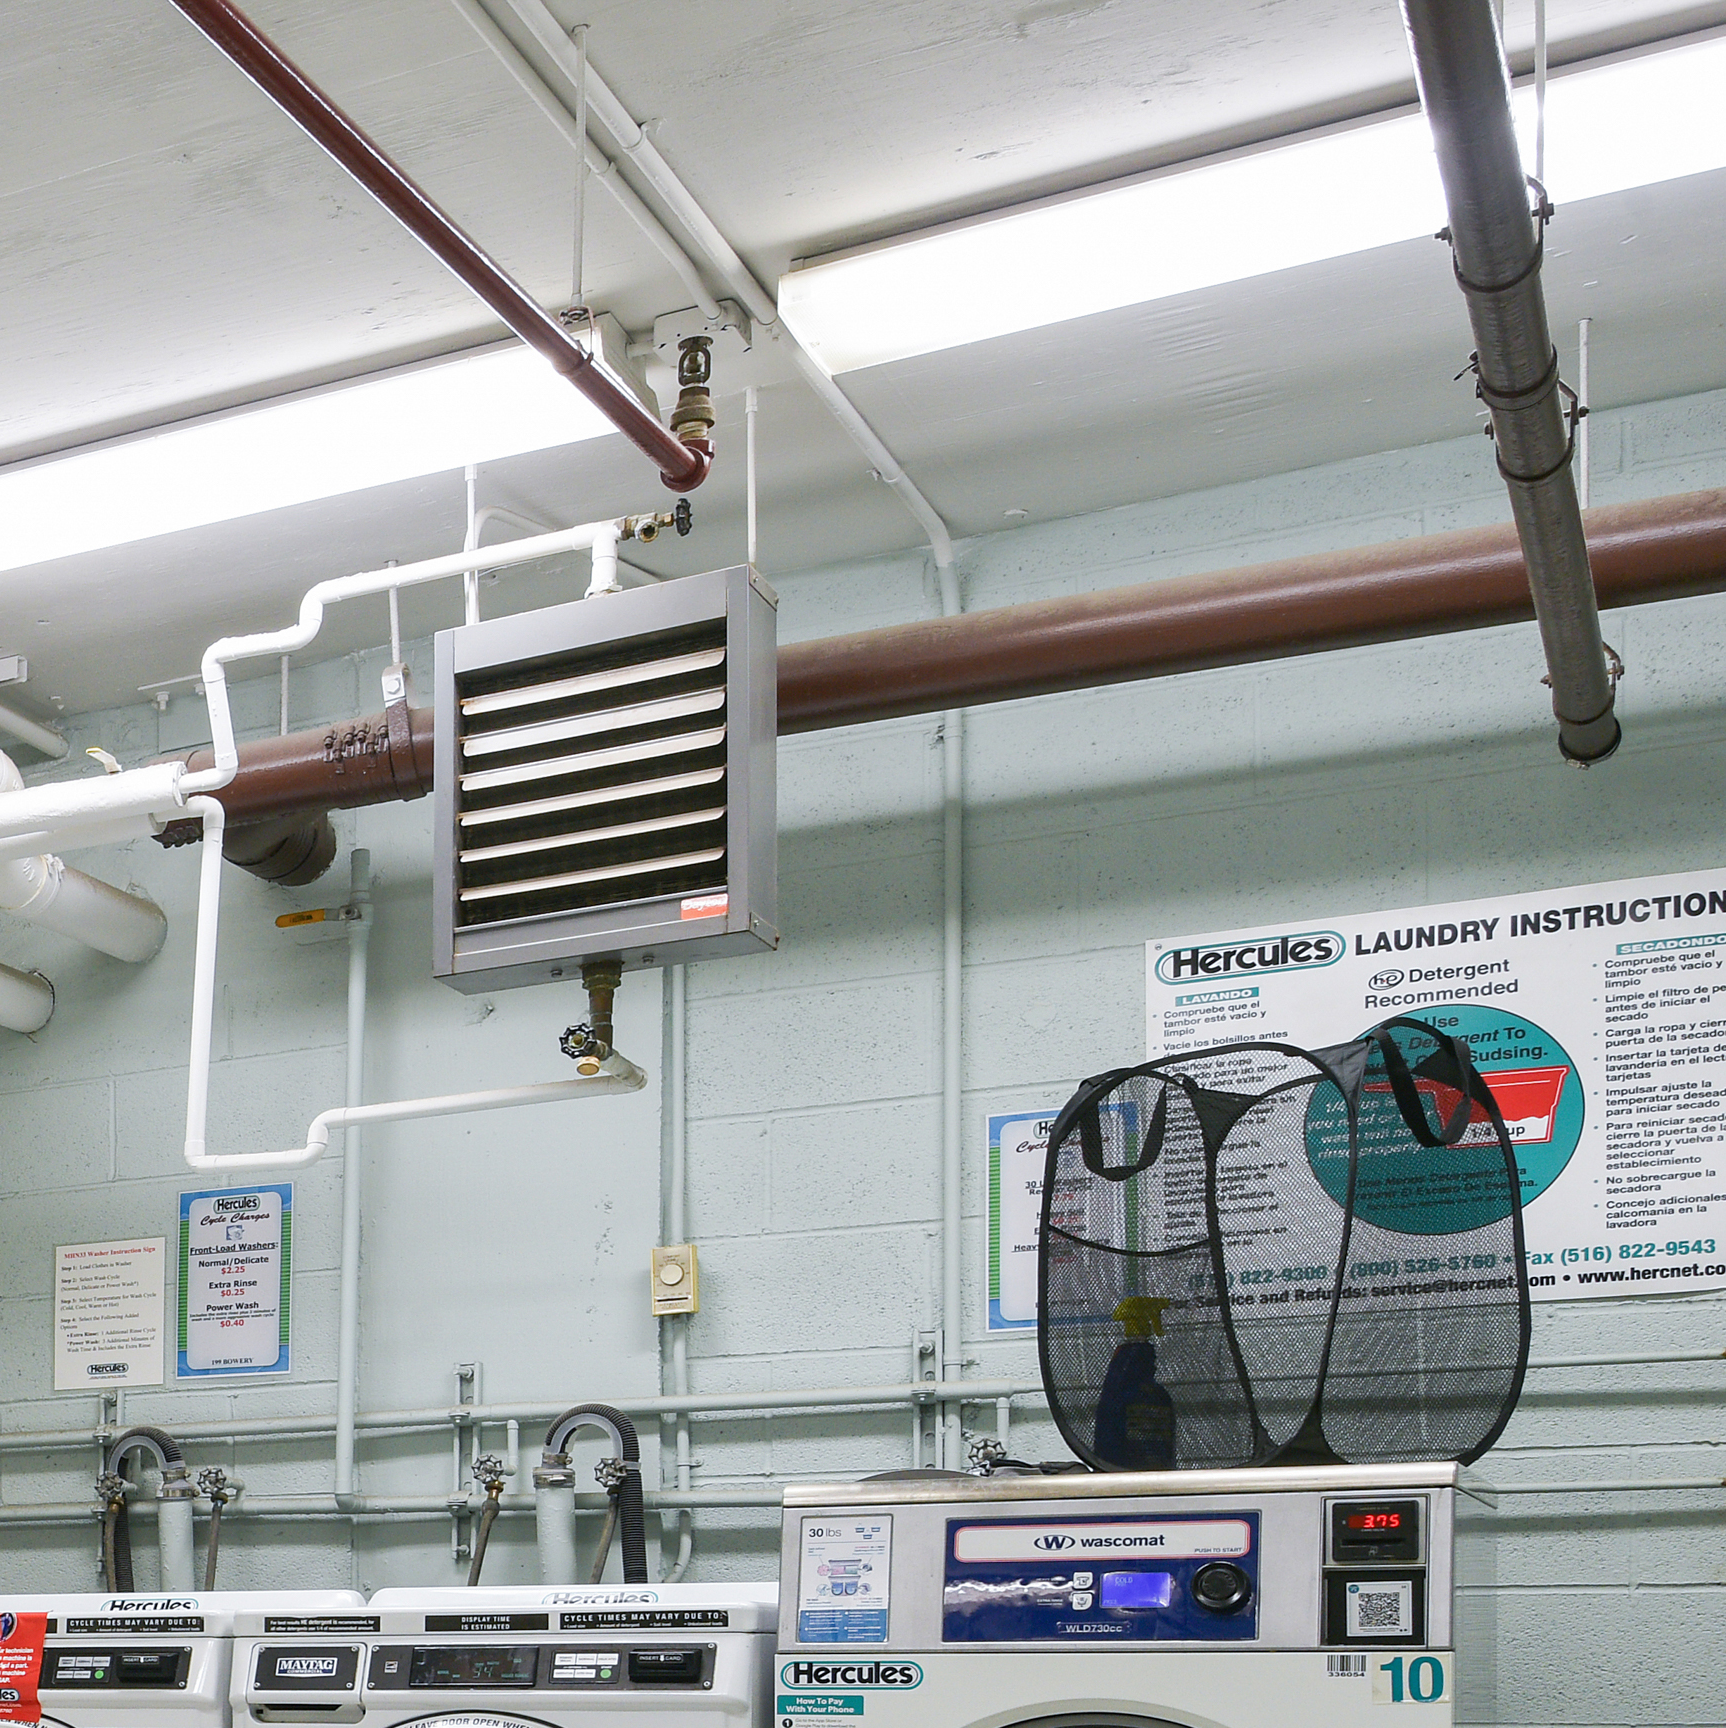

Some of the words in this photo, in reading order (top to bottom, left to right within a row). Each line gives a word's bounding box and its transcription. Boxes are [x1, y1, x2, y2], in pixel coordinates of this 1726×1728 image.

[1355, 917, 1500, 956] LAUNDRY
[1173, 937, 1333, 978] Hercules
[1605, 955, 1674, 968] Compruebe
[1679, 952, 1700, 961] que
[1705, 950, 1715, 958] el
[1409, 960, 1510, 984] Detergent
[1182, 989, 1252, 1005] LAVANDO
[1365, 979, 1519, 1009] Recommended
[1605, 992, 1644, 1003] Limpie
[1649, 990, 1658, 998] el
[1662, 988, 1690, 997] filtro
[1694, 986, 1708, 994] de
[1605, 1012, 1648, 1023] secado
[1606, 1038, 1644, 1049] puerta
[1667, 1034, 1676, 1042] la
[1606, 1071, 1651, 1083] tarjetas
[1606, 1084, 1658, 1097] Impulsar
[1661, 1082, 1698, 1092] ajuste
[1702, 1080, 1711, 1088] la
[1606, 1093, 1679, 1106] temperatura
[1606, 1106, 1632, 1118] para
[1636, 1103, 1672, 1113] iniciar
[1676, 1100, 1720, 1110] secado
[1607, 1122, 1632, 1131] Para
[1636, 1117, 1685, 1128] reiniciar
[1606, 1148, 1675, 1160] seleccionar
[1606, 1156, 1702, 1170] establecimiento
[217, 1197, 257, 1211] Hercules
[201, 1215, 226, 1226] Cycle
[231, 1213, 270, 1223] Charges
[190, 1244, 235, 1255] Front-Load
[239, 1242, 278, 1250] Washers:
[1561, 1246, 1612, 1266] (516)
[1619, 1239, 1716, 1259] 822-9543
[199, 1256, 269, 1267] Normal/Delicate
[221, 1266, 245, 1275] $2.25
[221, 1289, 245, 1297] $0.25
[207, 1303, 233, 1311] Power
[235, 1301, 259, 1309] Wash
[220, 1319, 244, 1327] $0.40
[91, 1364, 126, 1372] Hercules
[809, 1528, 823, 1538] 30
[825, 1528, 842, 1537] lbs
[1081, 1534, 1165, 1548] wascomat
[553, 1592, 650, 1604] Hercules
[110, 1599, 192, 1611] Hercules
[564, 1614, 594, 1622] CYCLE
[631, 1613, 651, 1621] MAY
[655, 1612, 680, 1620] VARY
[684, 1612, 703, 1620] DUE
[1066, 1624, 1122, 1633] WLD730cc
[279, 1659, 334, 1671] MAYTAG
[793, 1662, 913, 1684] Hercules
[1380, 1656, 1444, 1703] 10
[828, 1698, 843, 1706] Pay
[441, 1718, 470, 1727] DOOR
[473, 1717, 501, 1727] OPEN
